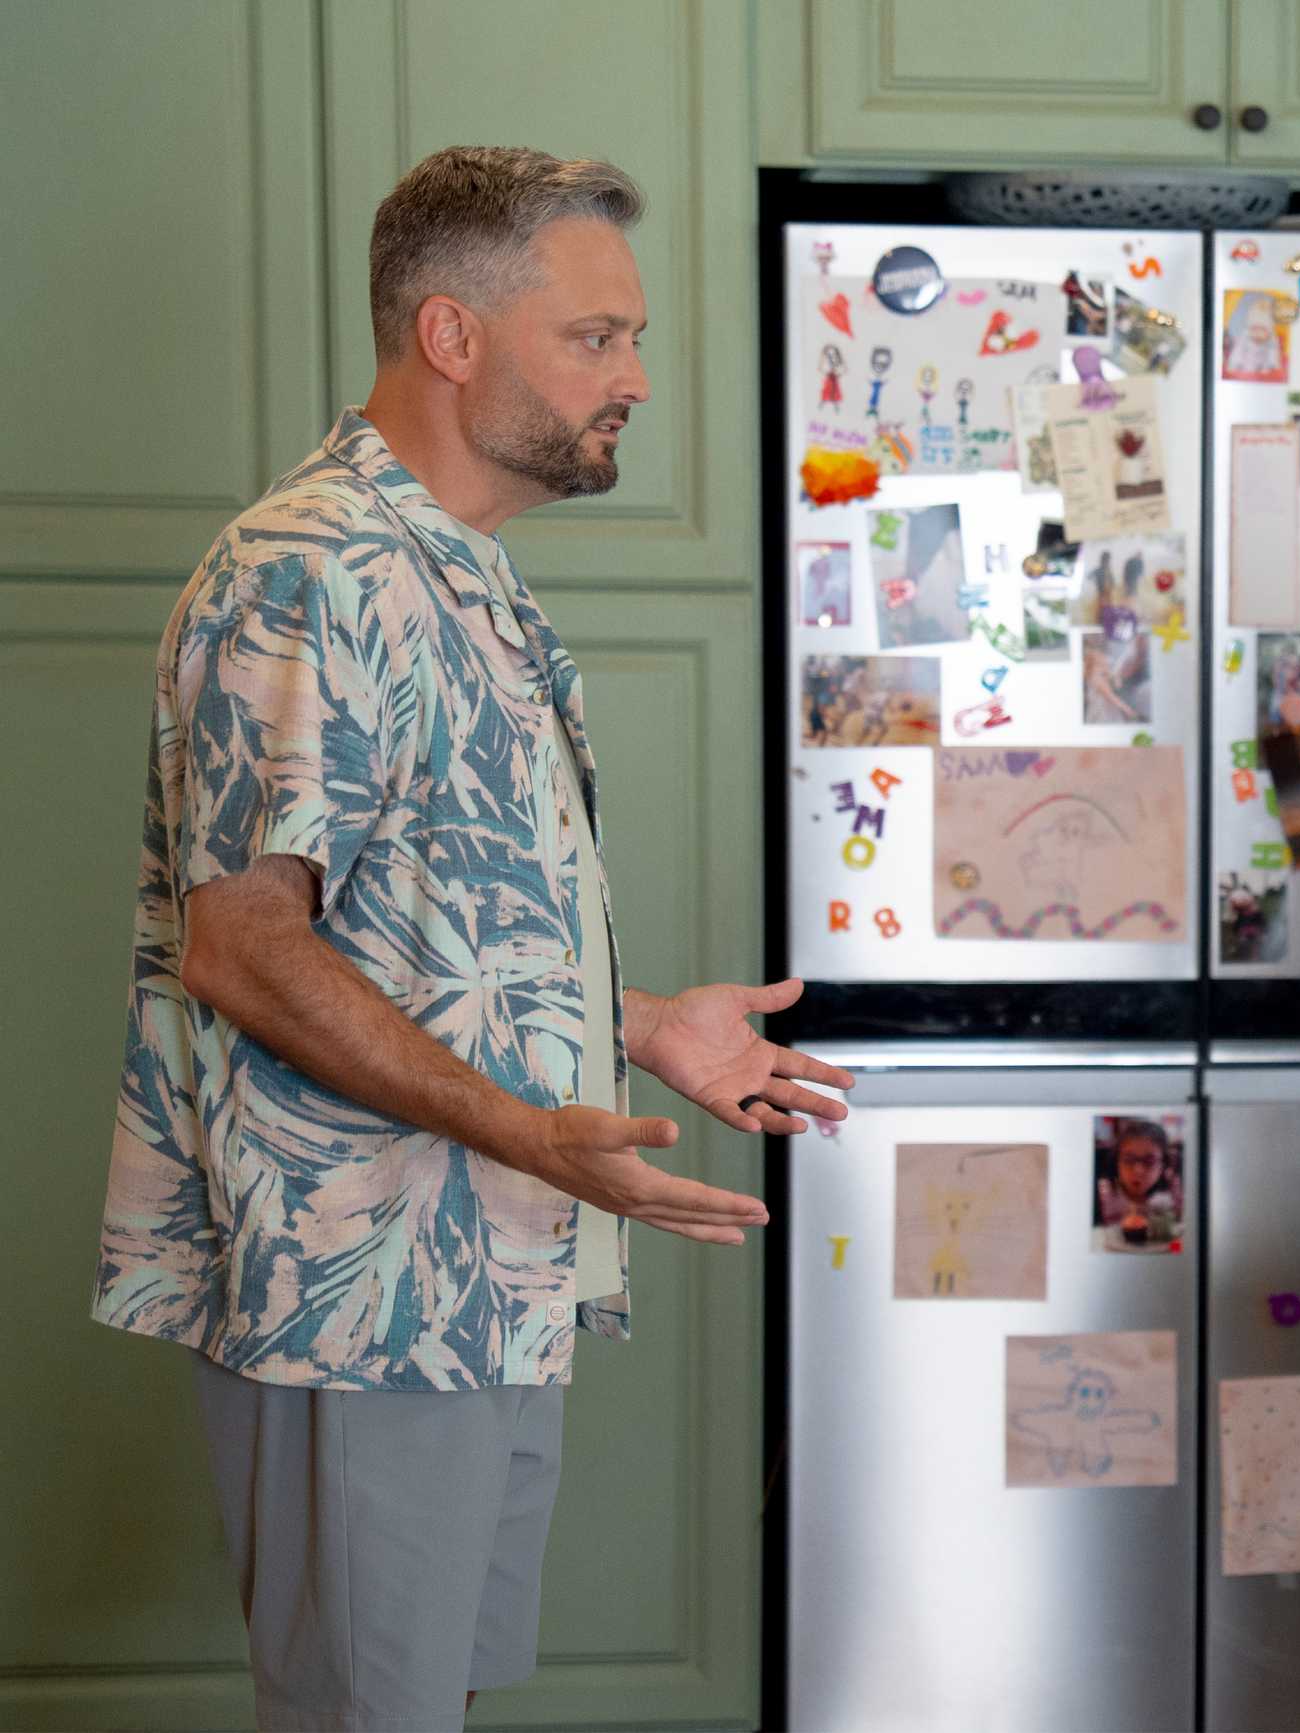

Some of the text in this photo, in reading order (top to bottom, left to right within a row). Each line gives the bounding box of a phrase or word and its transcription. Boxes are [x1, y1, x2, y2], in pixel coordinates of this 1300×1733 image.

[869, 768, 902, 800] A
[841, 834, 876, 870] O
[828, 900, 851, 932] R
[828, 1234, 853, 1270] T
